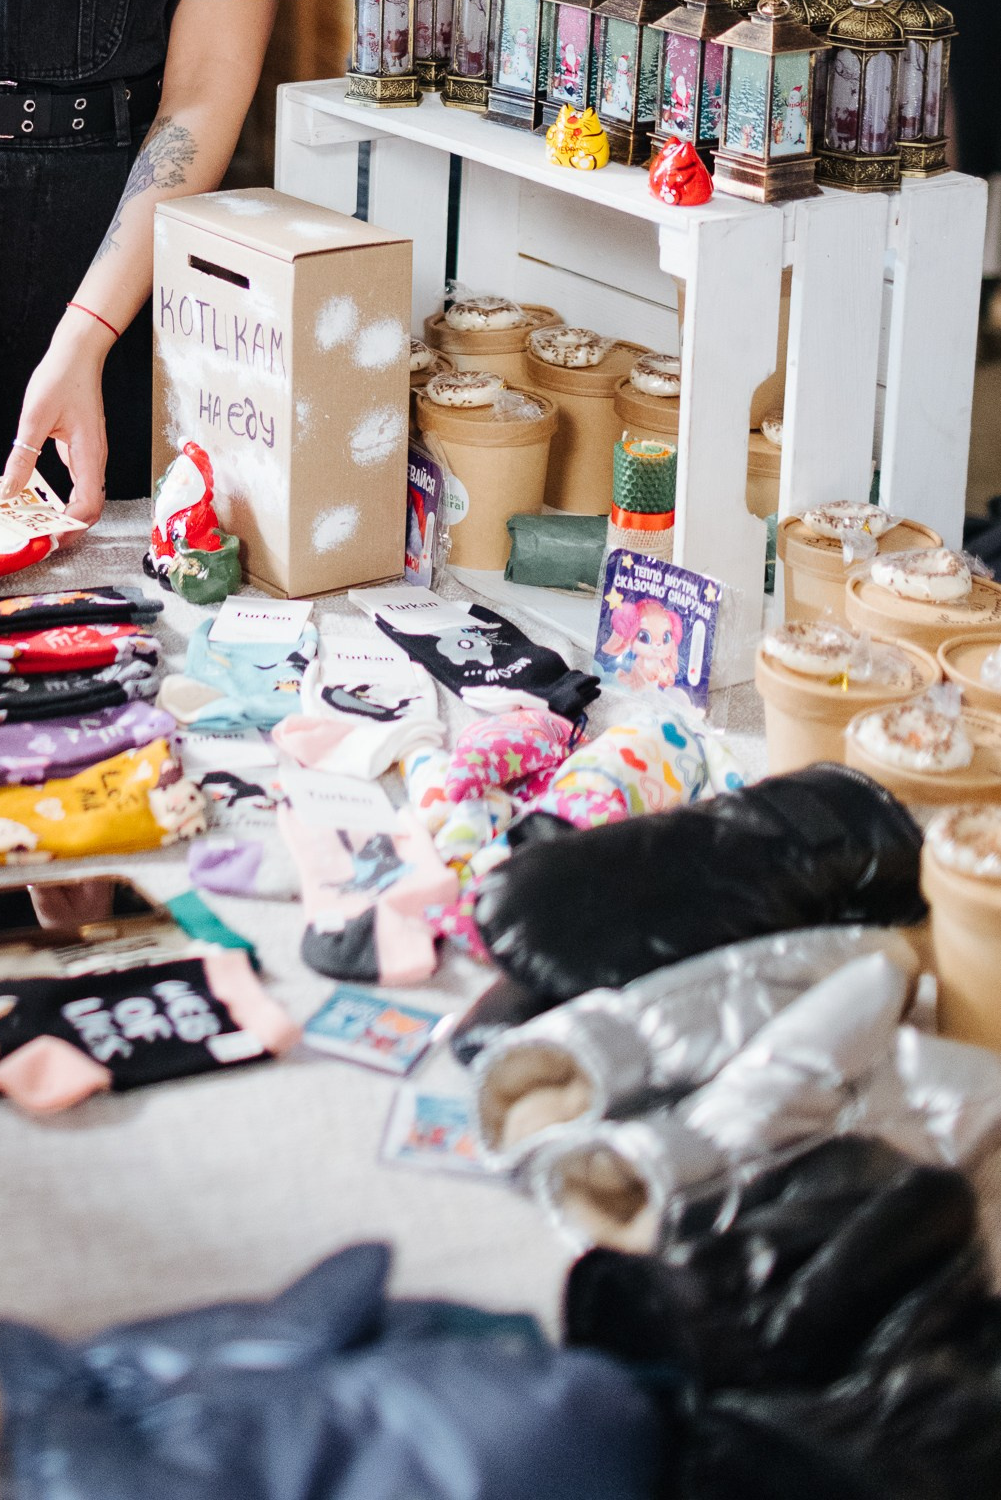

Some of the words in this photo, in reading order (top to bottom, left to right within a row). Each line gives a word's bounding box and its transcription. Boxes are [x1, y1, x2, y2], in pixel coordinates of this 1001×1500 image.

[634, 565, 662, 583] ТЕПЛО
[614, 574, 666, 599] СКАЗОЧНО
[668, 589, 712, 620] СНАРУЖИ
[384, 600, 438, 612] Turkan
[236, 611, 292, 621] Turkan
[336, 653, 395, 662] Turkan
